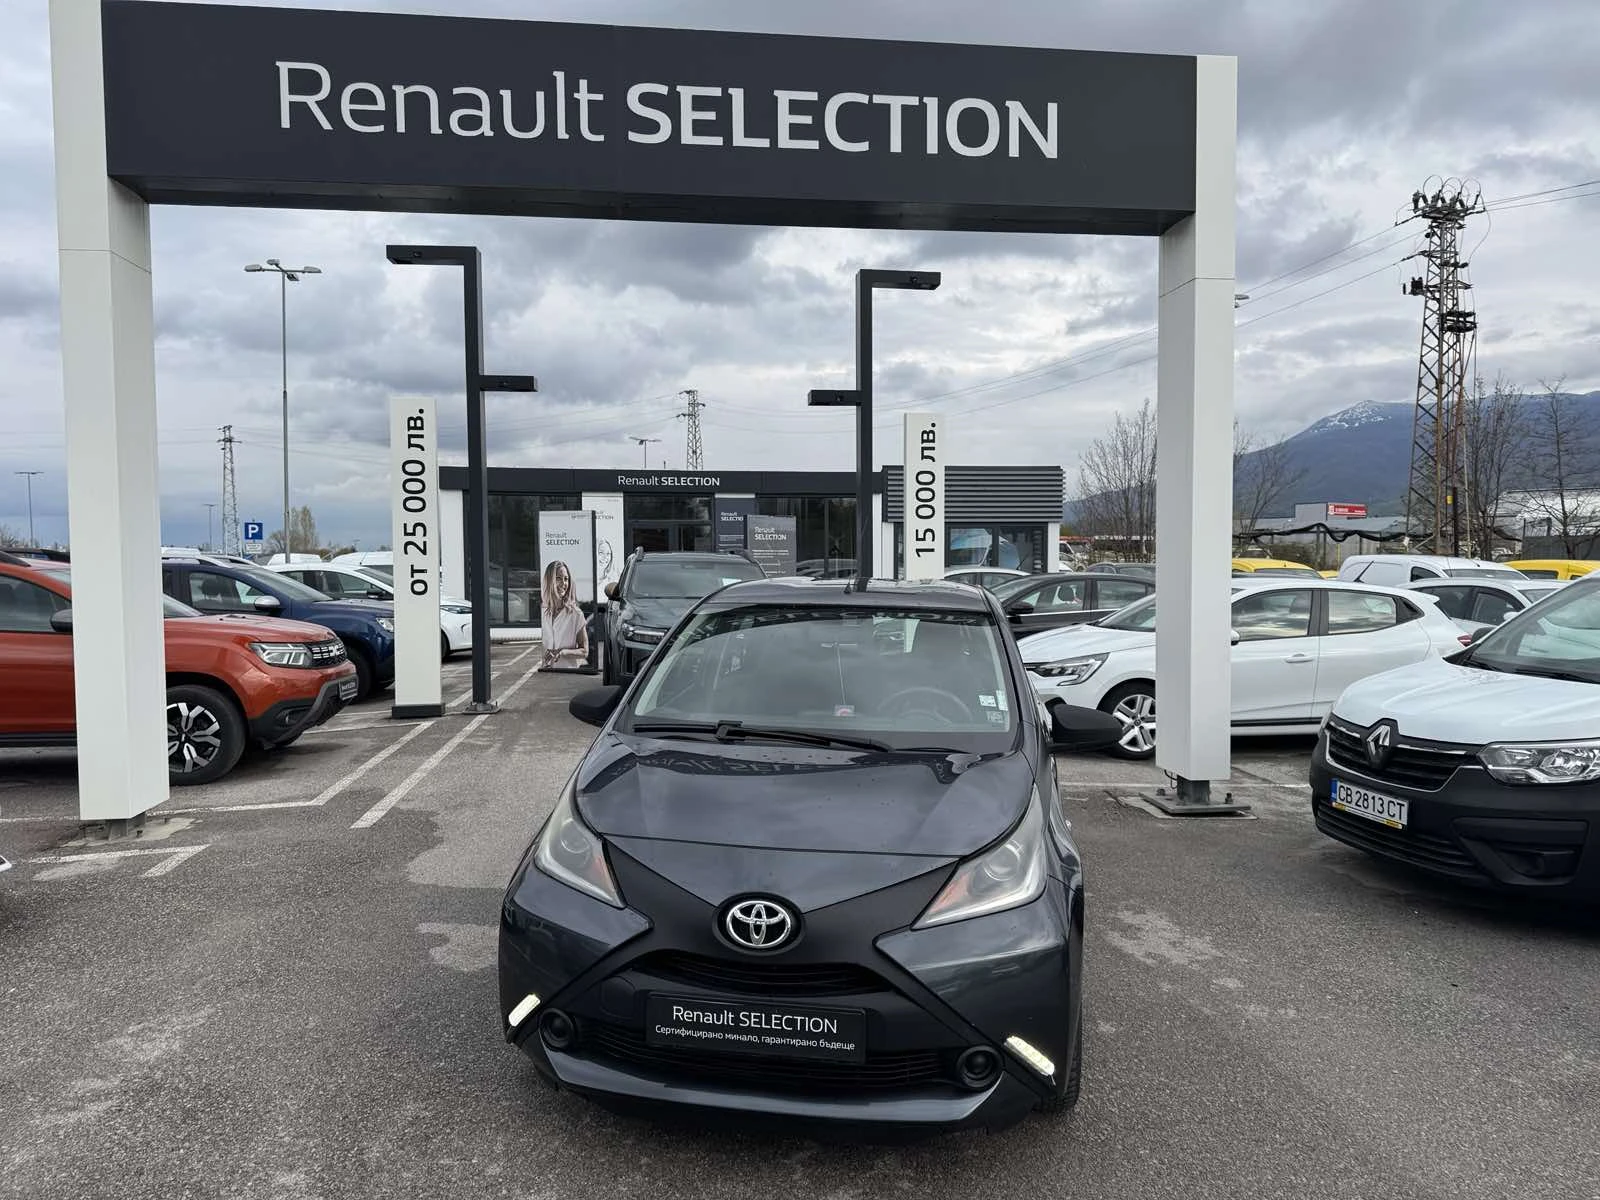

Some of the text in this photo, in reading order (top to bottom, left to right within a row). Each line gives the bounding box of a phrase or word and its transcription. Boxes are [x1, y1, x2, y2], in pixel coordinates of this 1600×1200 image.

[275, 61, 1058, 159] Renault SELECTION
[617, 475, 720, 487] Renault SELECTION
[915, 422, 936, 558] 15 000 лв.
[401, 408, 428, 596] от 25 000 лв.
[248, 524, 259, 539] P
[754, 533, 787, 541] SELECTION
[1338, 785, 1353, 805] CB
[1355, 790, 1385, 814] 2813
[1387, 800, 1405, 821] CT
[673, 1005, 837, 1034] Renault SELECTION
[655, 1024, 855, 1051] Сертифицирано минало, гарантирано бъдеще
